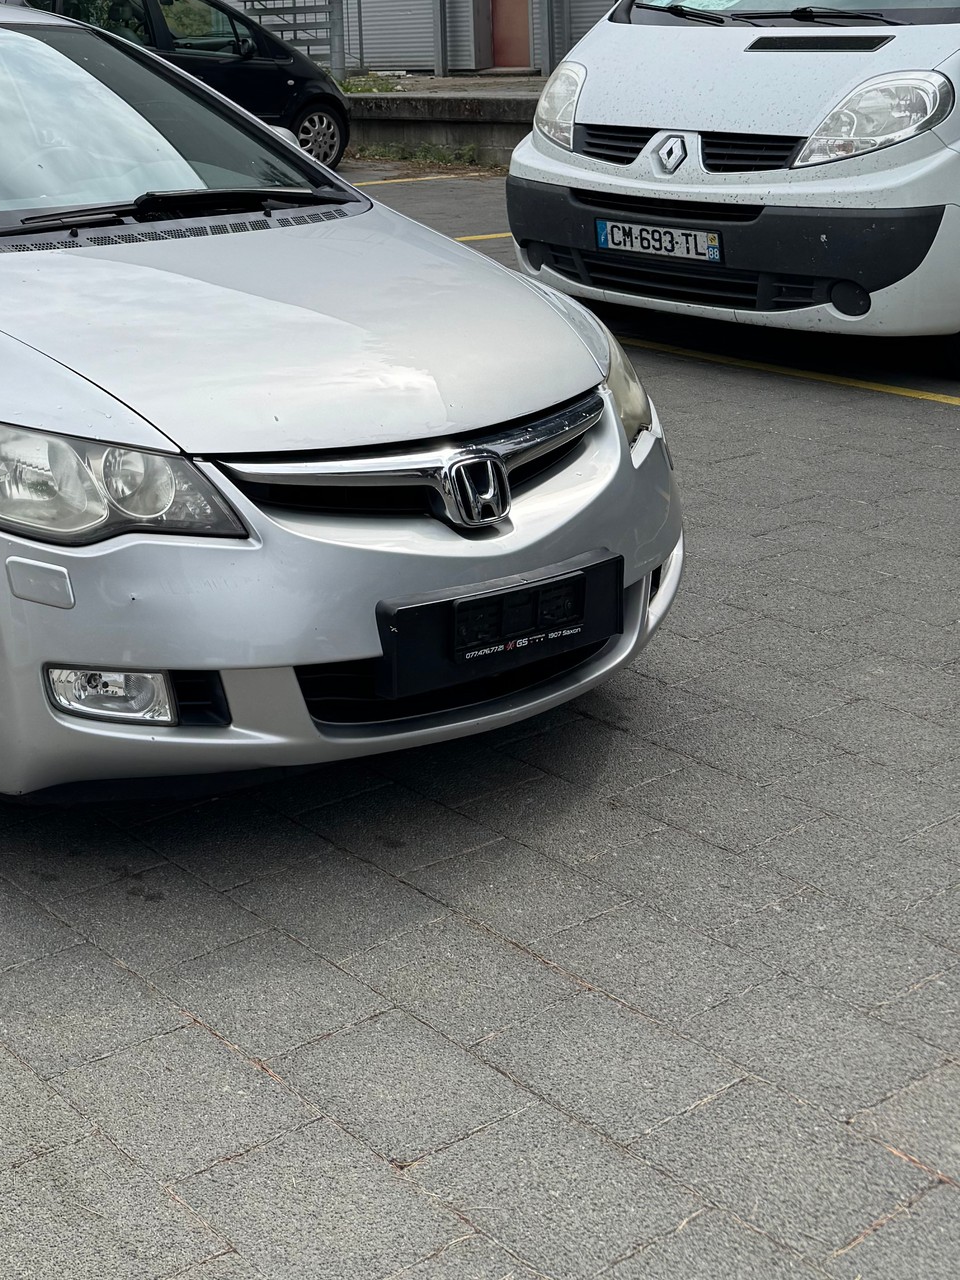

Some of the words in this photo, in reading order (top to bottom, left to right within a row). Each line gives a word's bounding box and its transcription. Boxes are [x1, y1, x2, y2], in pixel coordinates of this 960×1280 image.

[708, 247, 720, 260] 88
[516, 637, 529, 648] GS
[548, 630, 562, 639] 1907
[562, 627, 582, 636] Saxon
